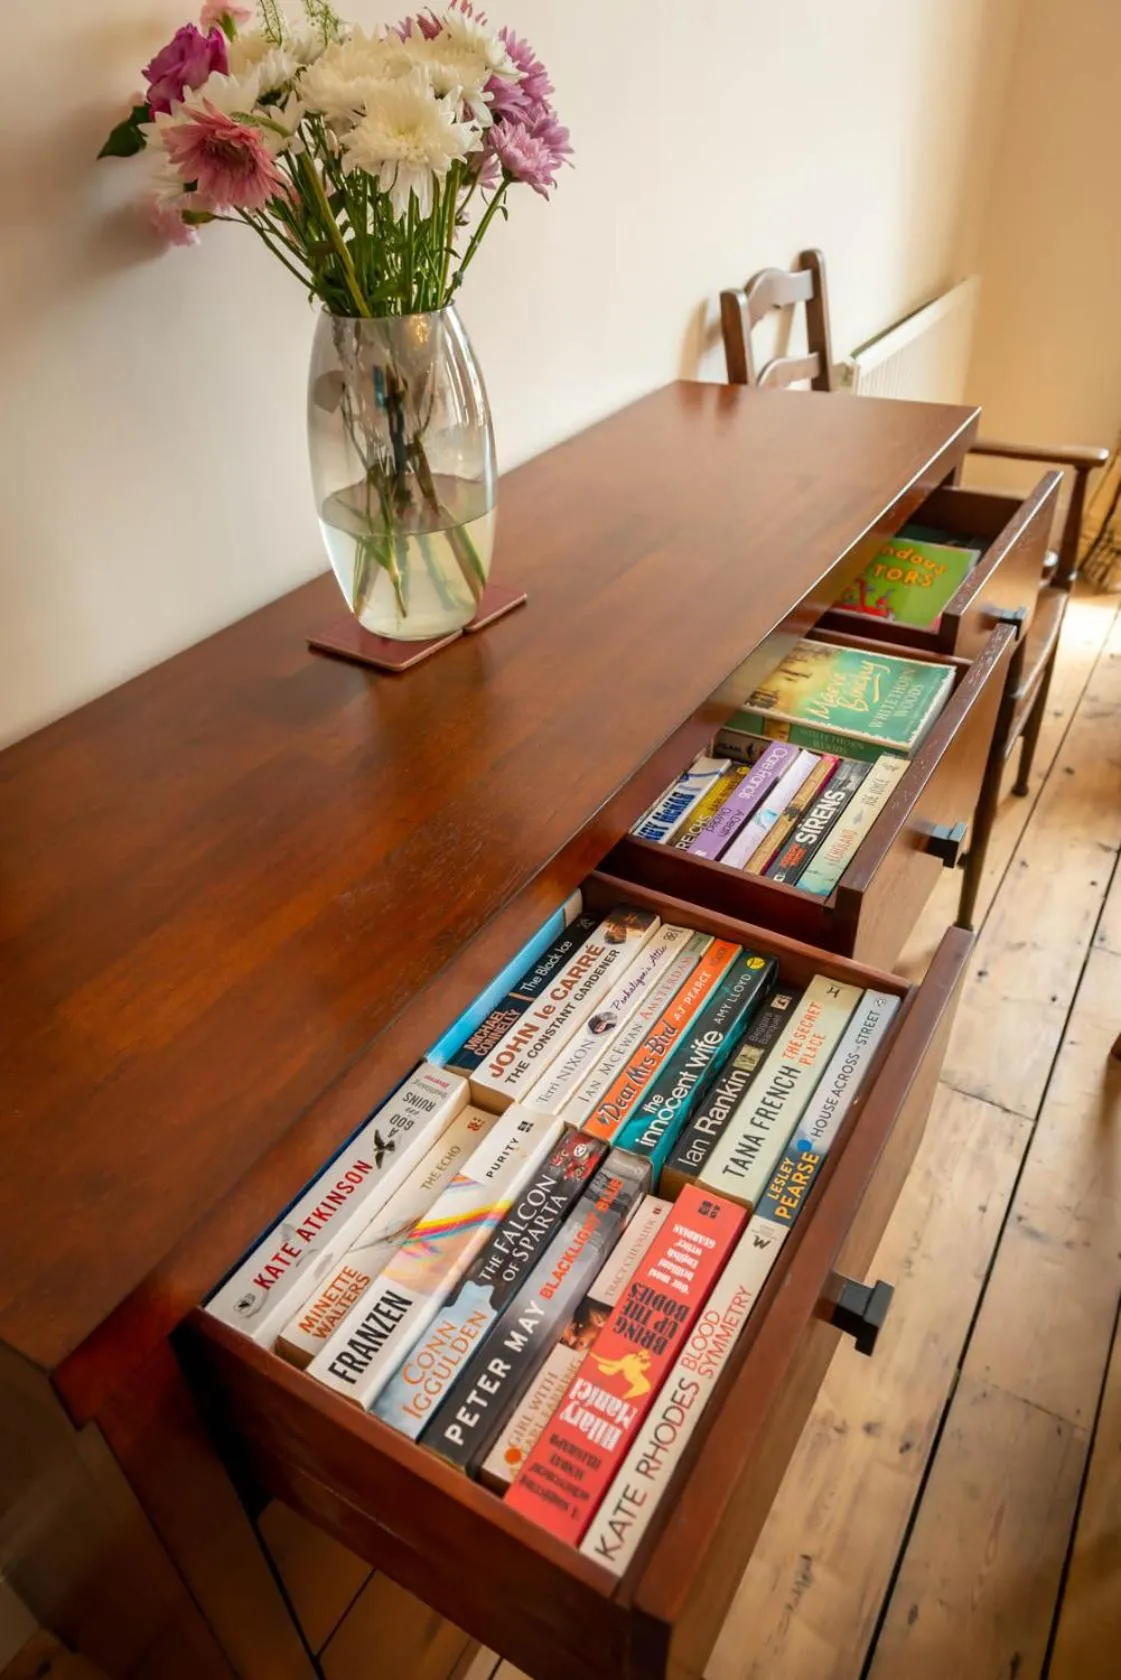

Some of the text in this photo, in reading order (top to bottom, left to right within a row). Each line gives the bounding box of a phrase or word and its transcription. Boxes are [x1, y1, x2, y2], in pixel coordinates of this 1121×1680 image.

[796, 789, 845, 846] SIRENS
[518, 939, 574, 993] The Black Ice
[639, 954, 691, 1020] AMSTERDAM
[713, 972, 753, 1025] AMY LLOYD
[463, 1009, 506, 1052] MICHAEL
[473, 1008, 521, 1056] CONNELLY
[488, 942, 607, 1079] JOHN le CARRÉ
[504, 948, 621, 1086] THE CONSTANT GARDENER
[783, 1001, 824, 1060] THE SECRET
[536, 1038, 597, 1104] Terri NIXON
[598, 1019, 679, 1126] Dear Mrs Bird
[798, 1032, 827, 1067] PLACE
[811, 1009, 882, 1138] HOUSE ACROSS STREET
[389, 1113, 416, 1132] GOD
[402, 1091, 437, 1113] RUINS
[578, 1079, 602, 1104] IAN
[635, 1070, 698, 1148] innocent
[643, 1093, 665, 1114] the
[677, 1068, 750, 1168] Ian Rankin
[722, 1133, 766, 1179] TANA
[750, 1065, 803, 1132] FRENCH
[419, 1145, 462, 1191] THE ECHO
[486, 1137, 520, 1178] PURITY
[766, 1156, 797, 1201] LESLEY
[774, 1151, 821, 1220] PEARSE
[253, 1158, 373, 1290] KATE ATKINSON
[479, 1173, 558, 1282] THE FALCON
[501, 1193, 568, 1282] OF SPARTA
[538, 1175, 625, 1301] BLACKLIGHT BLUE
[604, 1215, 657, 1299] TRACY CHEVALIER
[298, 1265, 360, 1332] MINETTE
[312, 1273, 371, 1341] WALTERS
[622, 1298, 681, 1342] UP THE
[628, 1282, 691, 1323] BODIES
[327, 1289, 414, 1385] FRANZEN
[401, 1319, 457, 1386] CONN
[402, 1310, 489, 1420] IGGULDEN
[613, 1313, 671, 1356] BRING
[680, 1308, 720, 1373] BLOOD
[700, 1284, 754, 1380] SYMMETRY
[444, 1299, 546, 1446] PETER MAY
[568, 1376, 640, 1428] Mantel
[507, 1371, 559, 1447] GIRL WITH
[559, 1405, 625, 1453] Hilary
[594, 1375, 701, 1563] KATE RHODES
